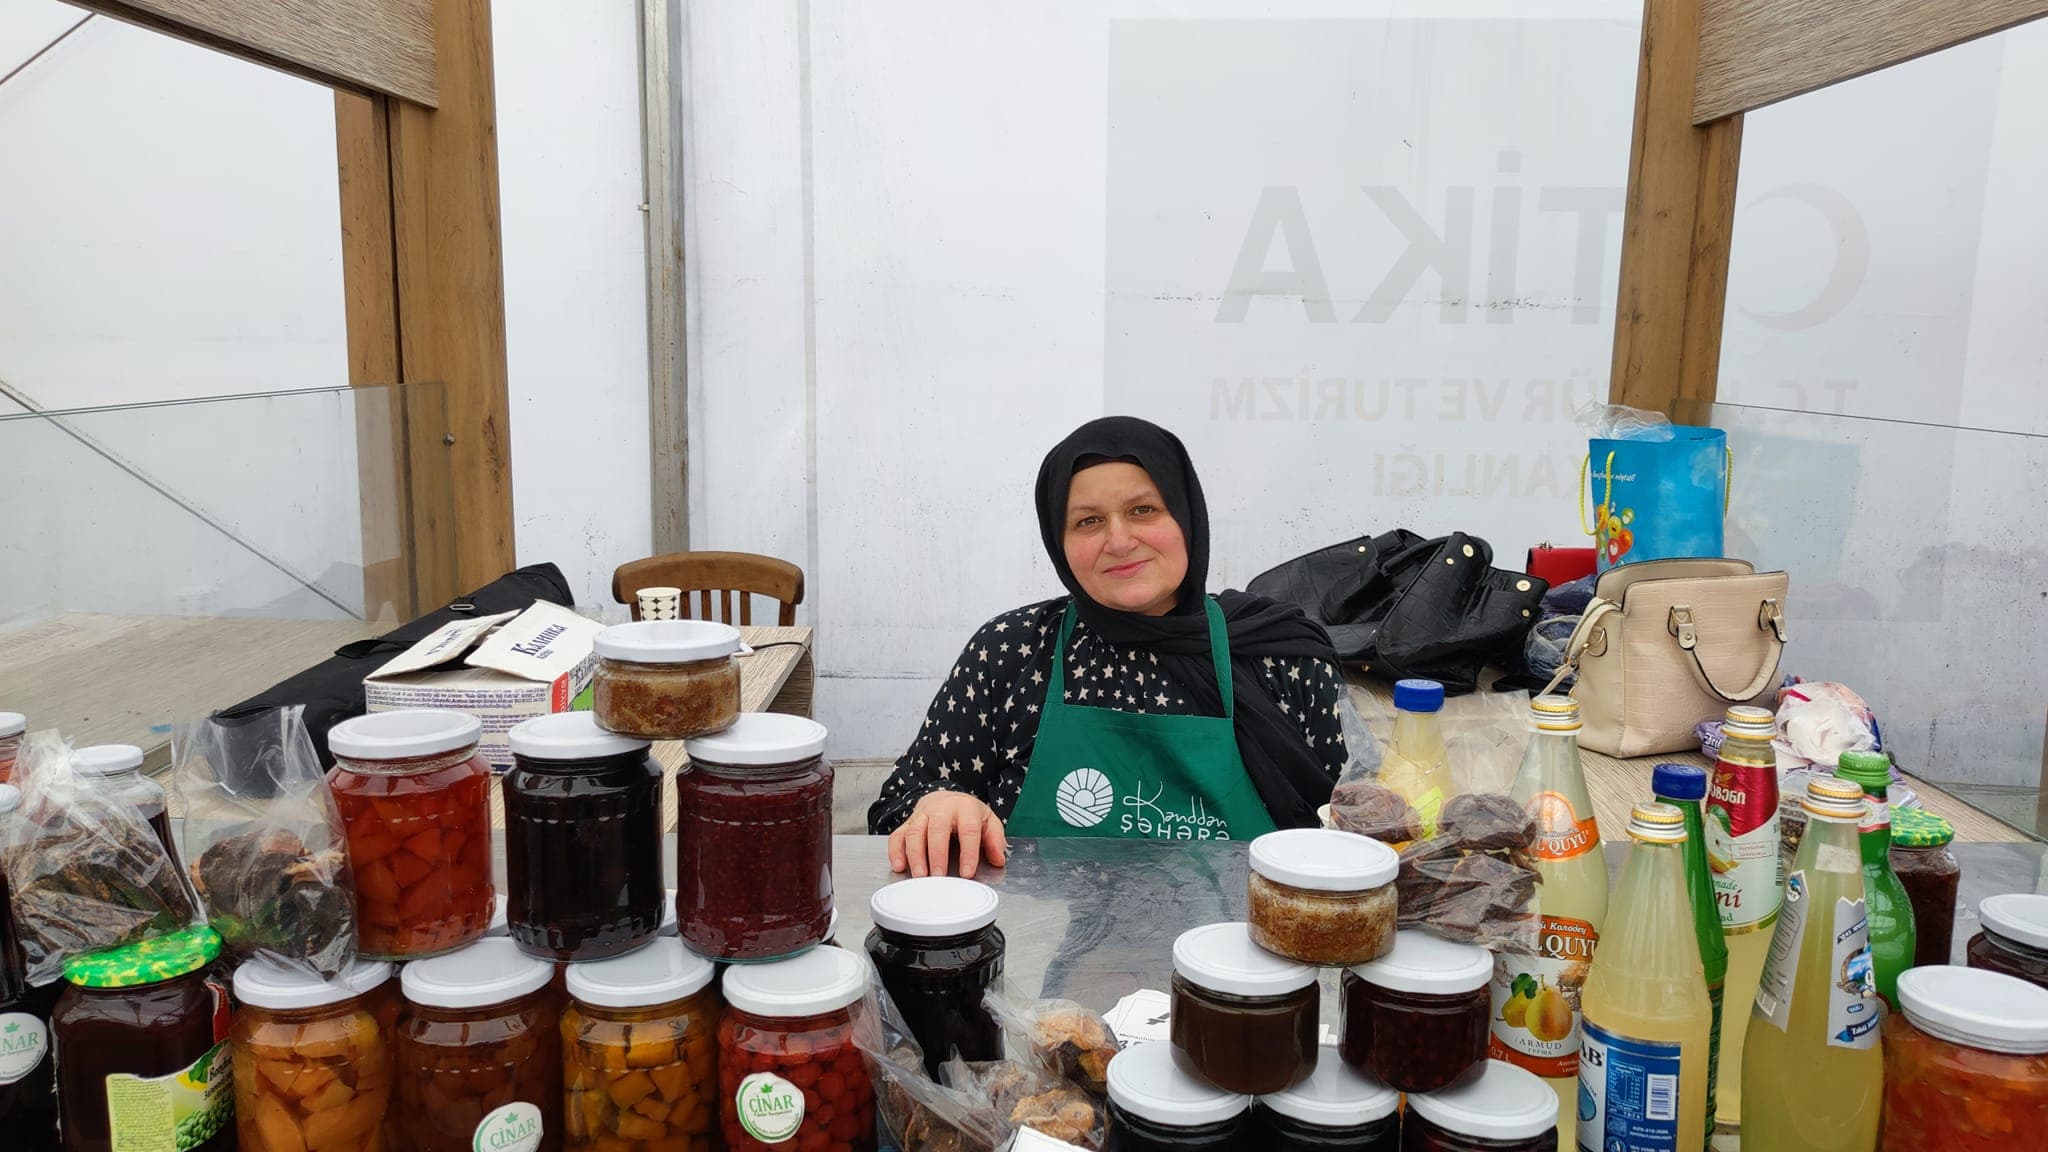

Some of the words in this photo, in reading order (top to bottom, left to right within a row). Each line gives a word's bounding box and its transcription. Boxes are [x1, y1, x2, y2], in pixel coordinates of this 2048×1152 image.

[1549, 831, 1587, 856] QUYU
[0, 1031, 38, 1052] NAR
[1519, 1038, 1562, 1050] ARMUD
